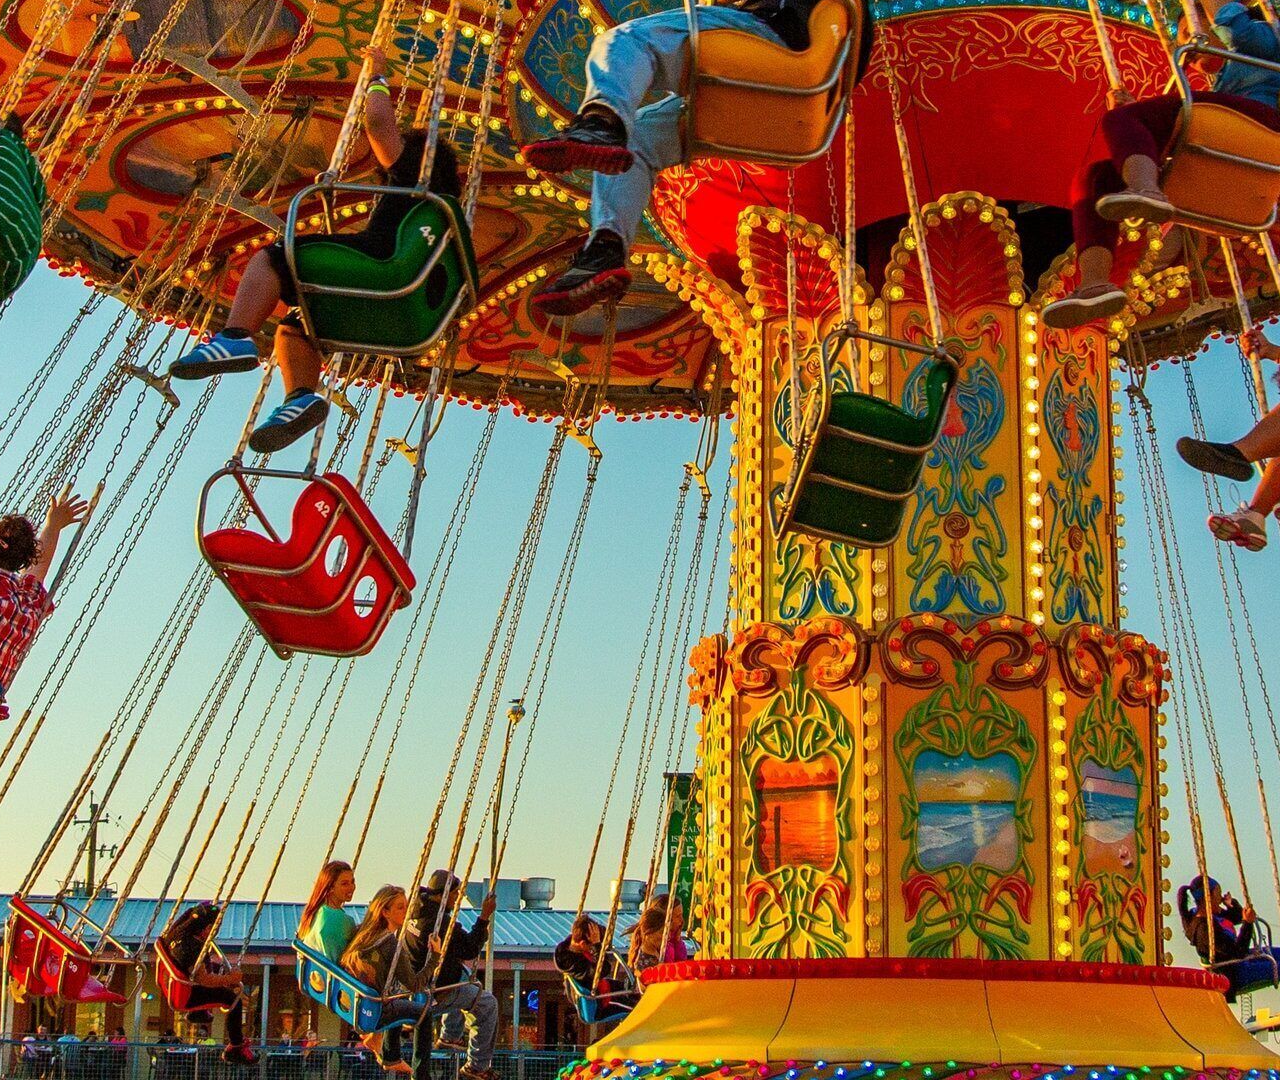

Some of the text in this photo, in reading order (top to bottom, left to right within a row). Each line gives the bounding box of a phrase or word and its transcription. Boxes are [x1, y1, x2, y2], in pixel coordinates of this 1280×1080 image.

[419, 226, 437, 246] 44
[314, 500, 331, 518] 42
[68, 961, 78, 973] 59
